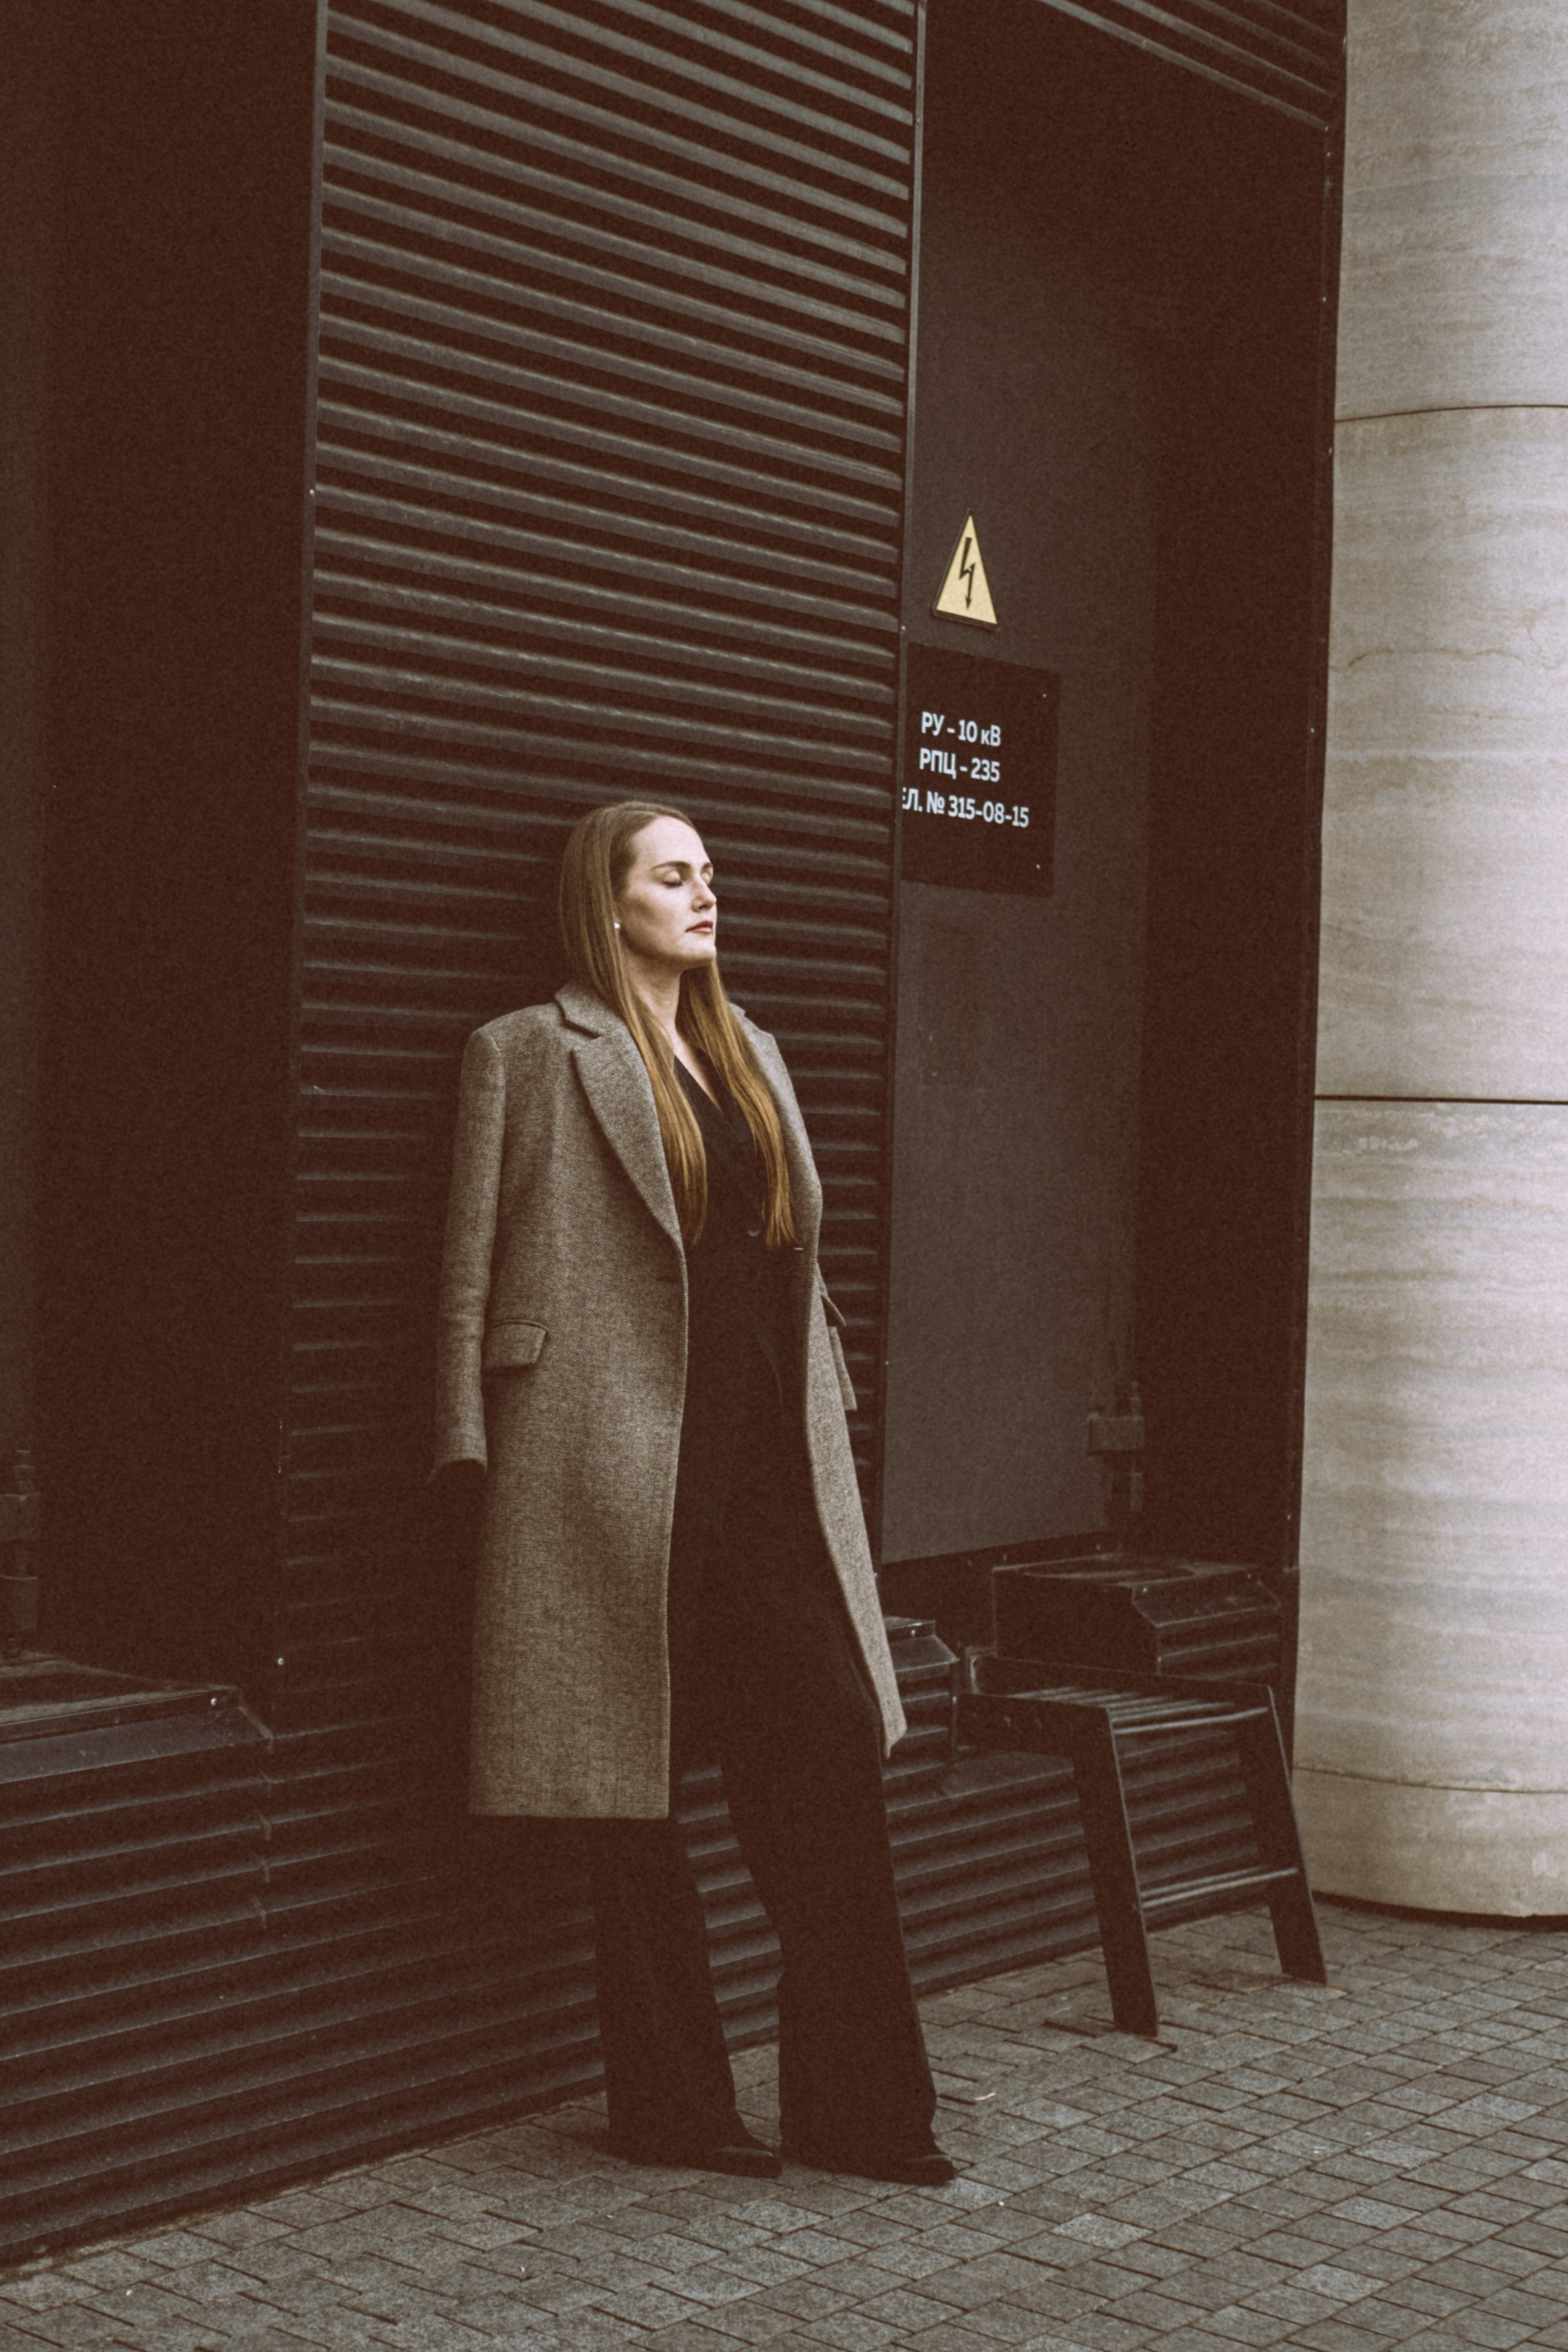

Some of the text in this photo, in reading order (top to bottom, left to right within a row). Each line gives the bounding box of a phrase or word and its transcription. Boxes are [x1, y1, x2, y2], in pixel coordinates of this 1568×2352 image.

[921, 711, 945, 736] РУ
[958, 719, 978, 743] 10
[981, 725, 1001, 747] кВ
[919, 747, 957, 780] РПЦ
[970, 757, 1000, 783] 235
[926, 790, 945, 815] №
[948, 794, 1029, 828] 315-08-15
